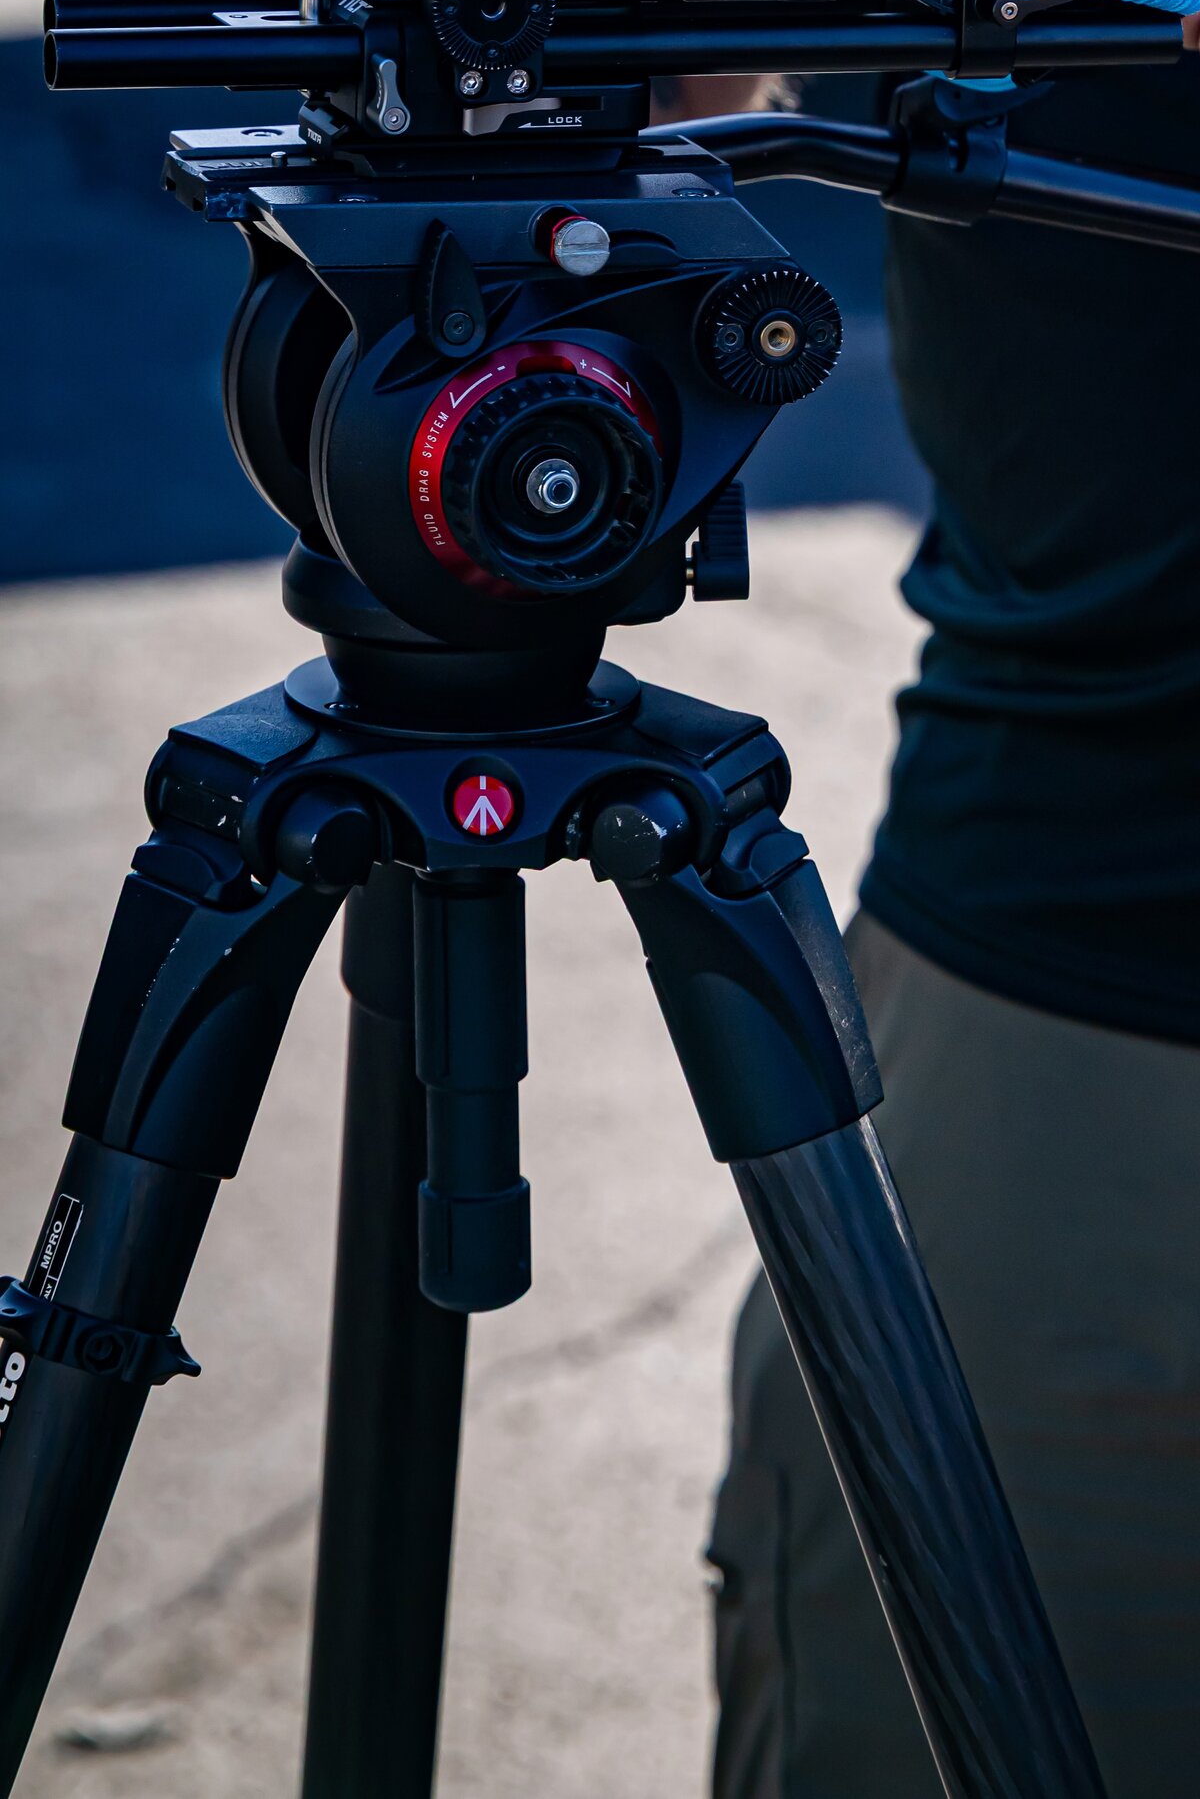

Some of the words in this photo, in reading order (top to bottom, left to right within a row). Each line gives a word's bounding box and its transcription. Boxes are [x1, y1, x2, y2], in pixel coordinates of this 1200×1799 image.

[548, 116, 582, 124] LOCK
[422, 411, 449, 459] SYSTEM
[418, 469, 430, 502] DRAG
[423, 513, 446, 546] FLUID
[40, 1220, 63, 1270] MPRO
